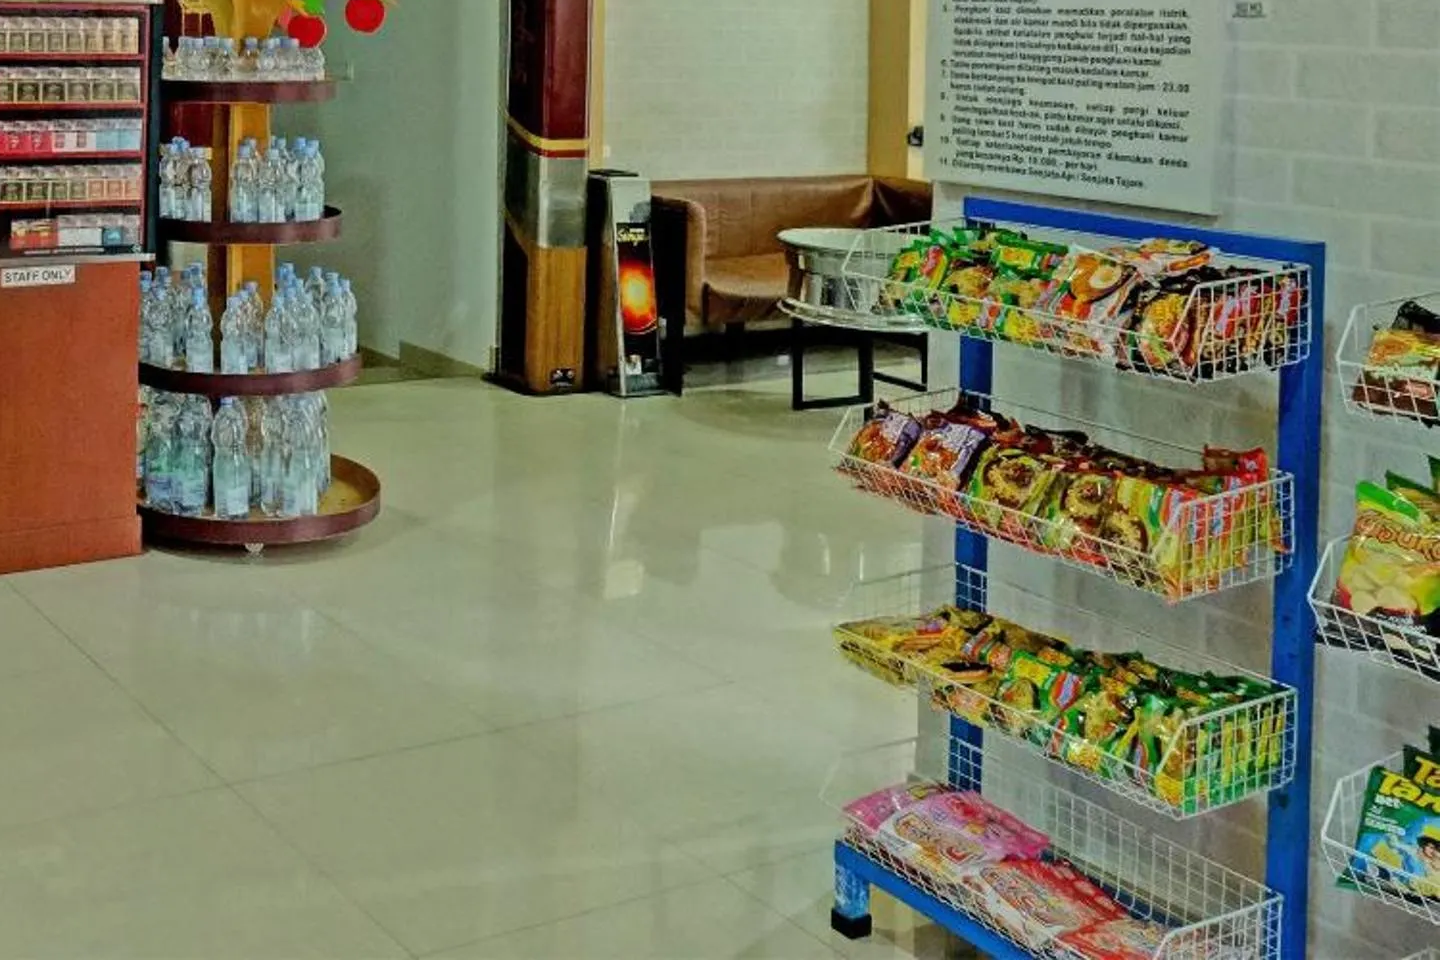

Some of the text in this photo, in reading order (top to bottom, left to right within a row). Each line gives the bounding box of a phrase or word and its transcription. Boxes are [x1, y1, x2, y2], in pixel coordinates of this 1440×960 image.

[4, 268, 73, 283] STAFF ONLY
[1378, 769, 1440, 814] Tar
